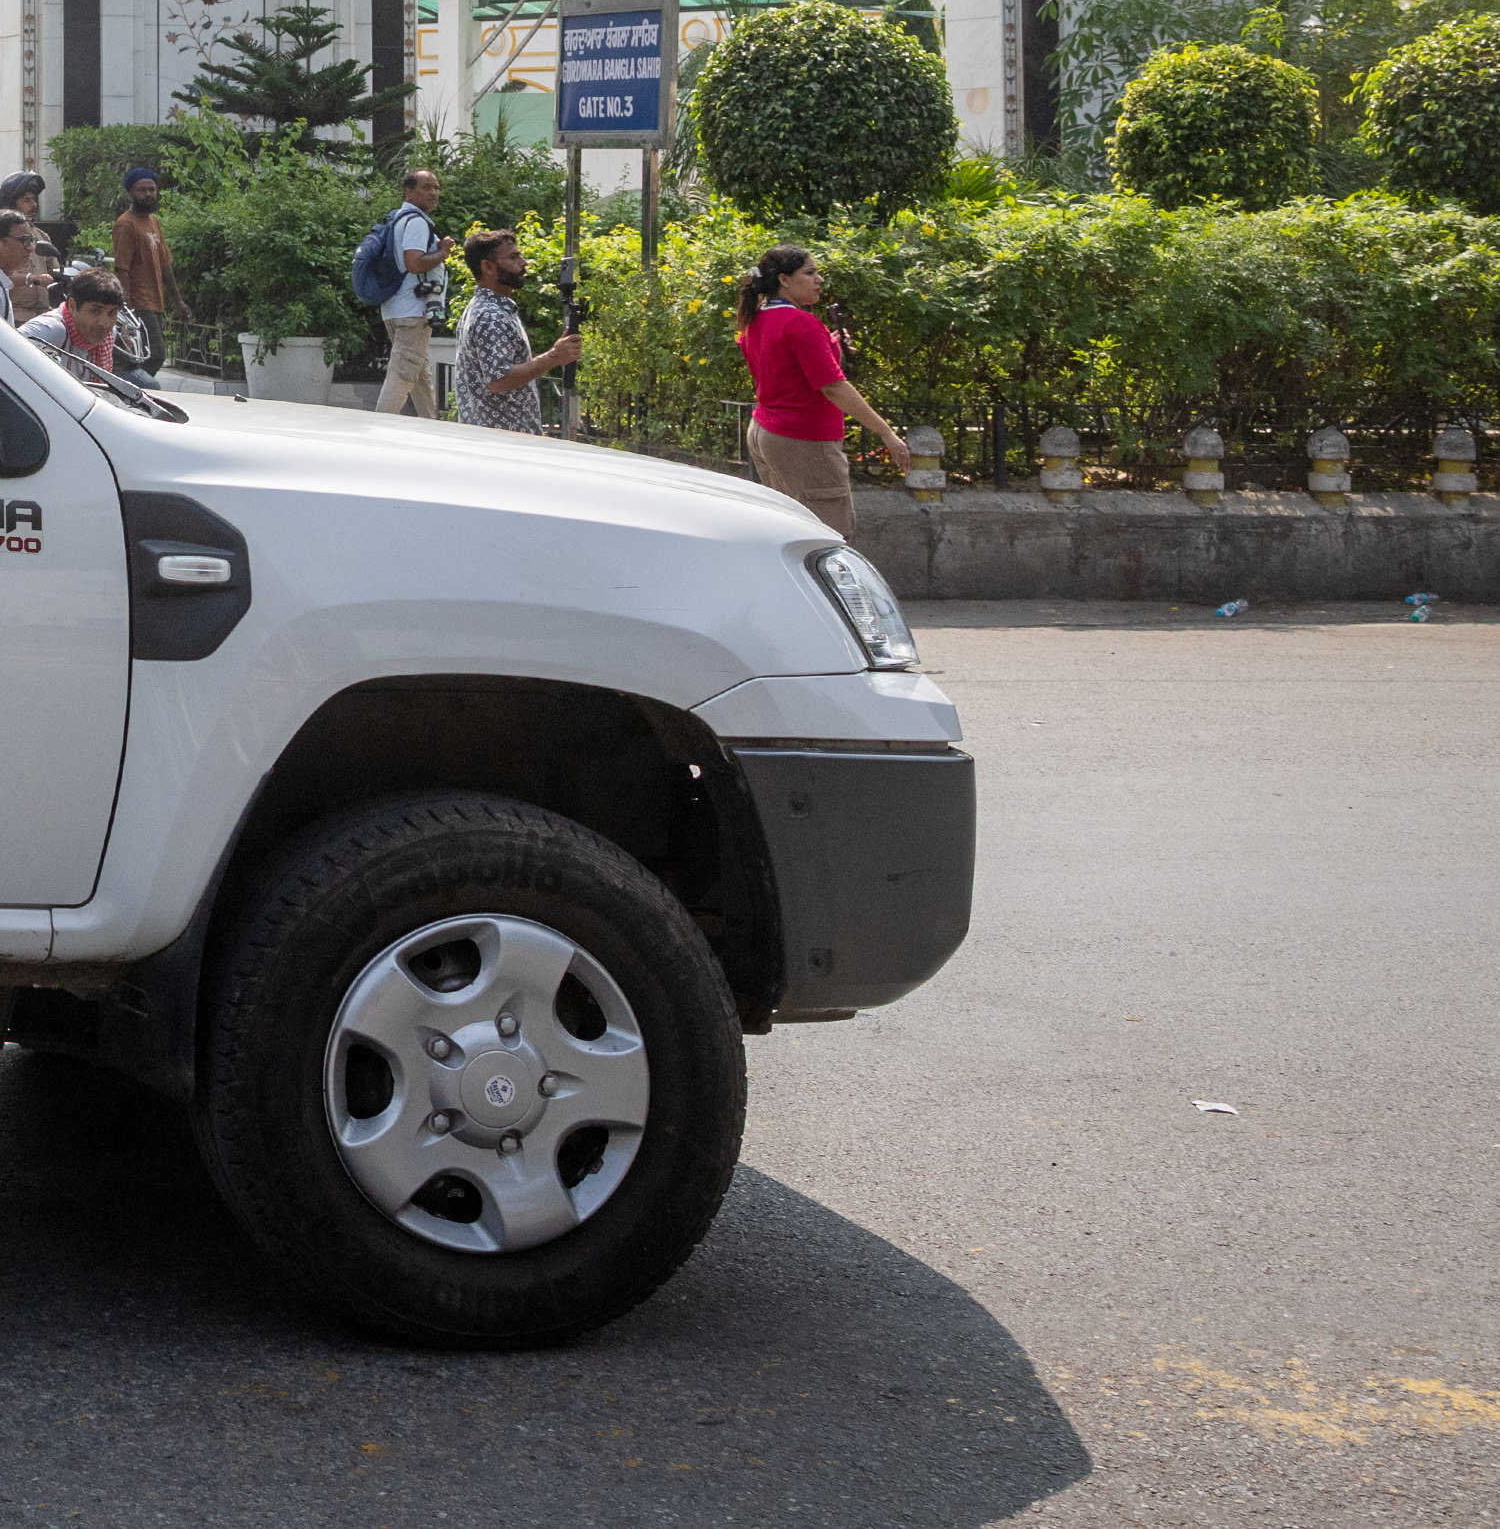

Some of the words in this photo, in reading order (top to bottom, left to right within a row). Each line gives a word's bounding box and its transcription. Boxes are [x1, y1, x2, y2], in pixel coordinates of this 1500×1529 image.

[564, 28, 606, 57] ਗੁਰਦੁਆਰਾ
[606, 20, 632, 49] ਬੰਗਲਾ
[631, 18, 660, 48] ਸਾਹਿਬ
[562, 59, 603, 84] GURDWARA
[604, 58, 635, 81] BANGLA
[636, 56, 662, 79] SAHIB
[579, 96, 605, 118] GATE
[607, 95, 634, 118] NO.3
